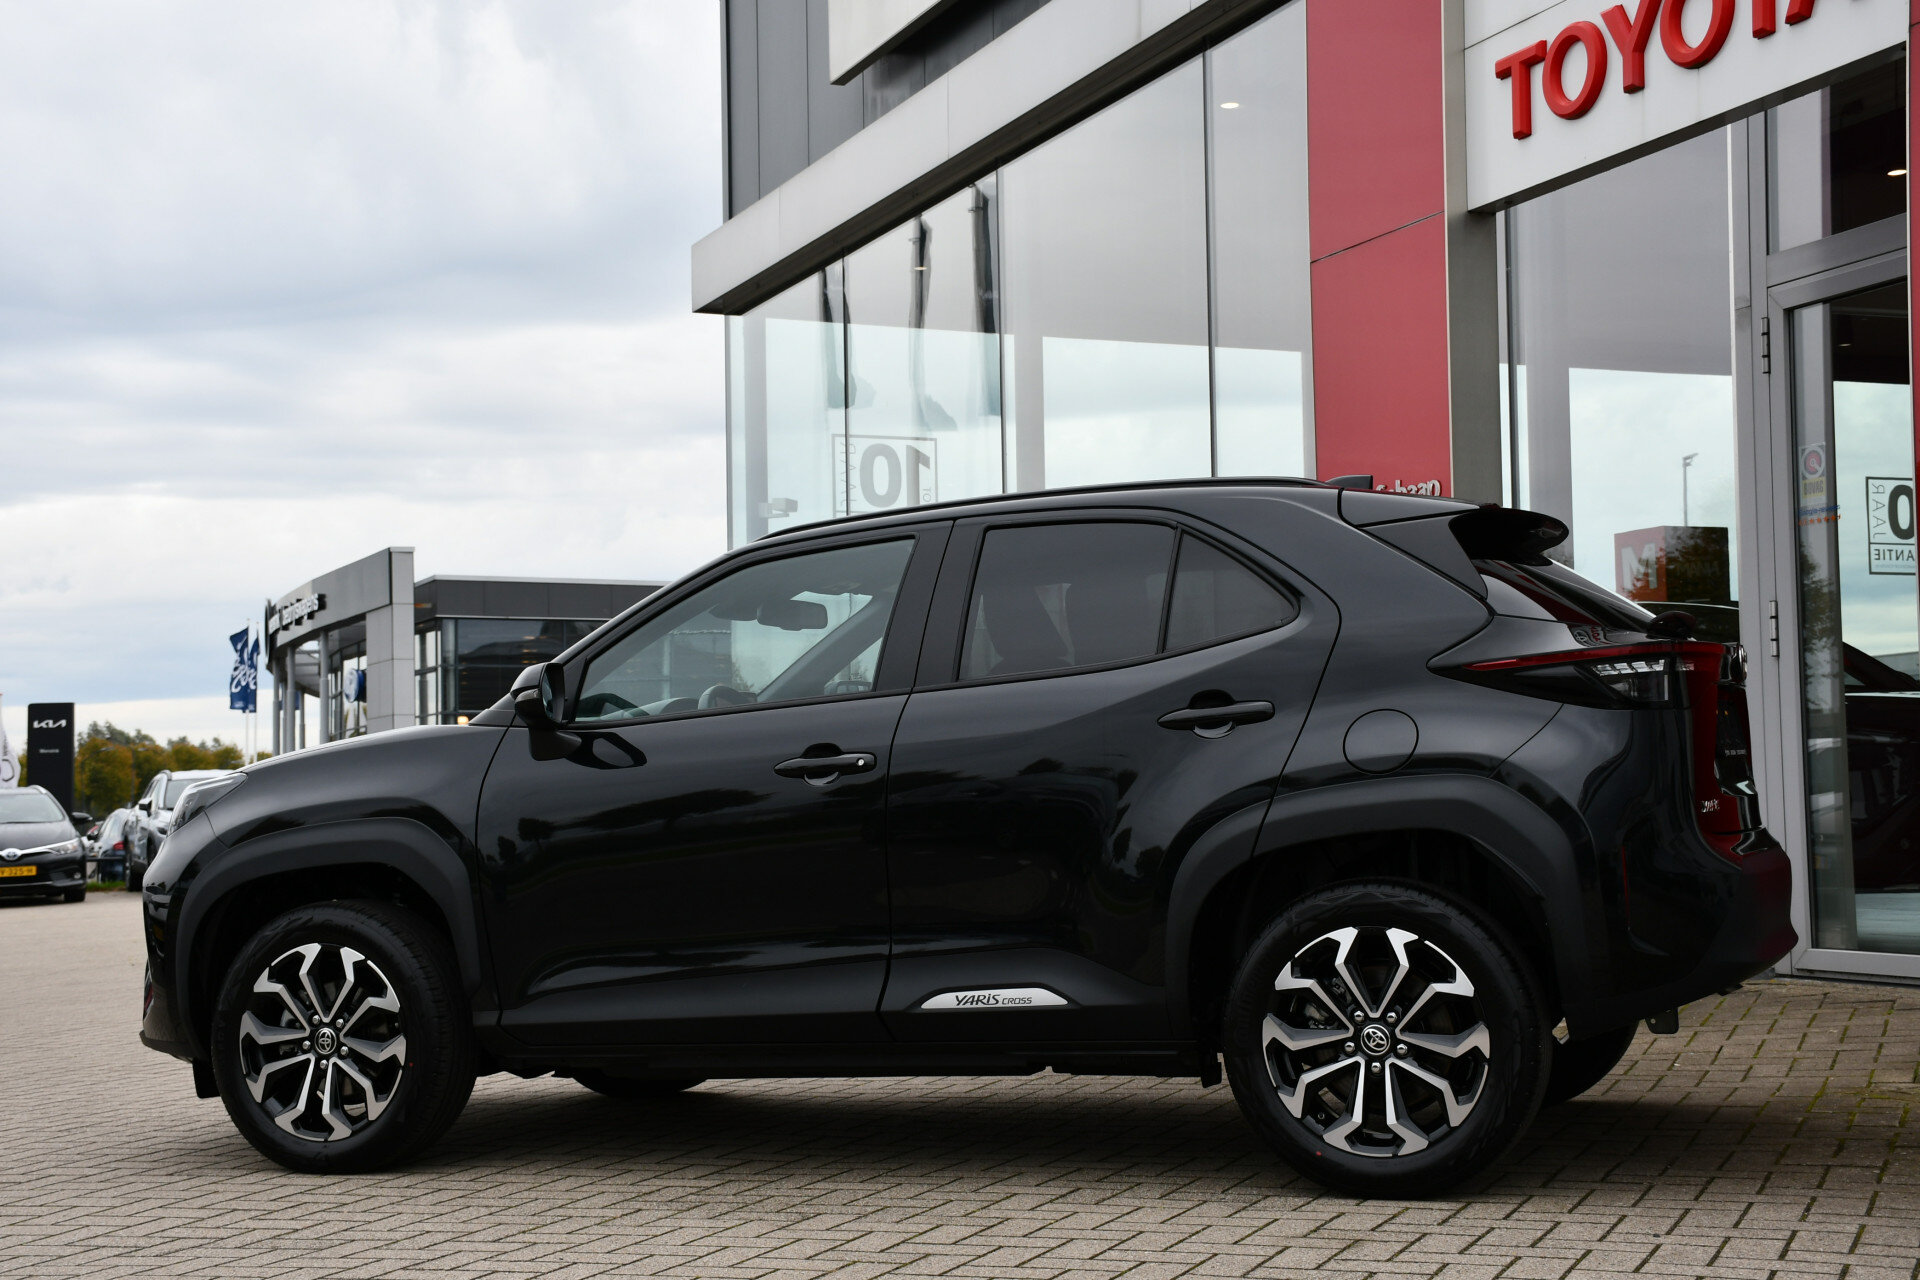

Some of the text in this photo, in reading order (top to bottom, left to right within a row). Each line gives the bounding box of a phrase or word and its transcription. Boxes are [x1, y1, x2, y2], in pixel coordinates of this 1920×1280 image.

[1495, 0, 1816, 140] TOYO
[33, 719, 67, 729] KIA
[1001, 996, 1033, 1005] CROSS
